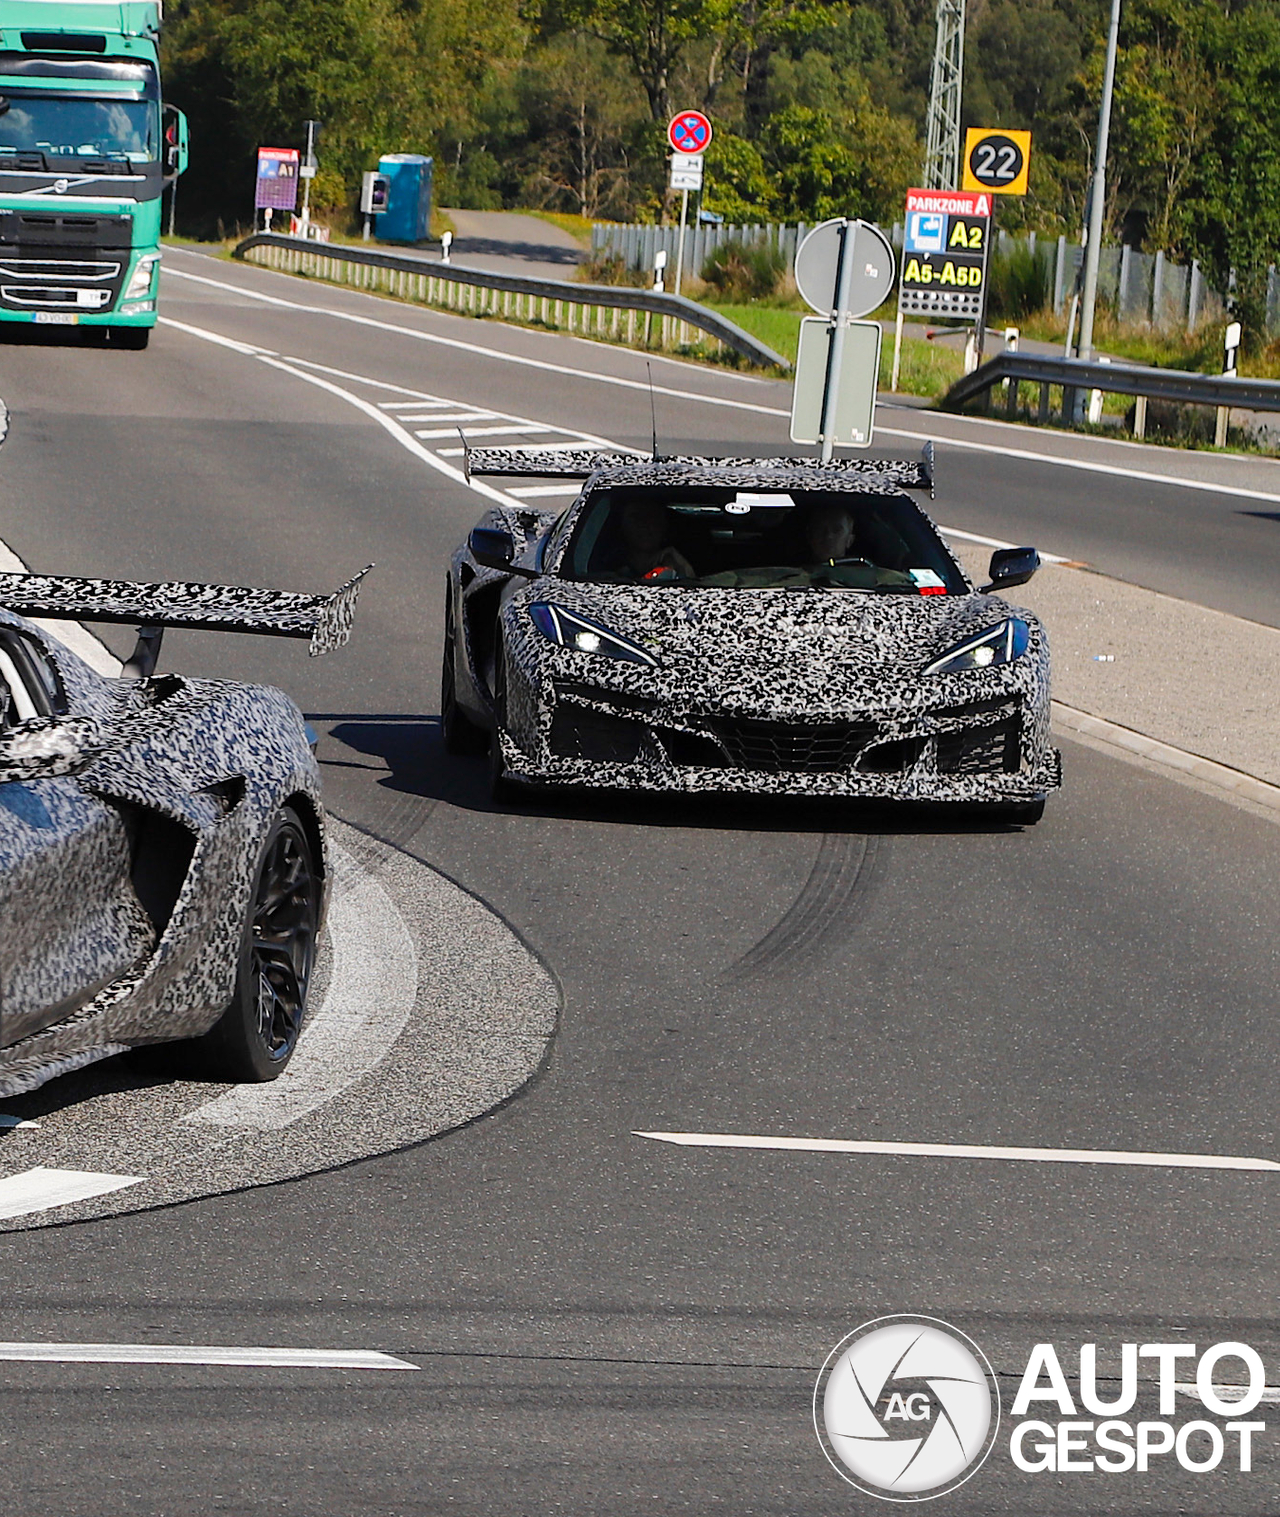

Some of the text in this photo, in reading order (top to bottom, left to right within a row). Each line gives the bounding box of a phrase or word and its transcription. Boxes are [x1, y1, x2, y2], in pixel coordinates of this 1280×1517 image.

[975, 144, 1017, 179] 22
[907, 195, 990, 215] PARKZONE A
[949, 221, 983, 249] A2
[904, 259, 982, 287] A5-A5D
